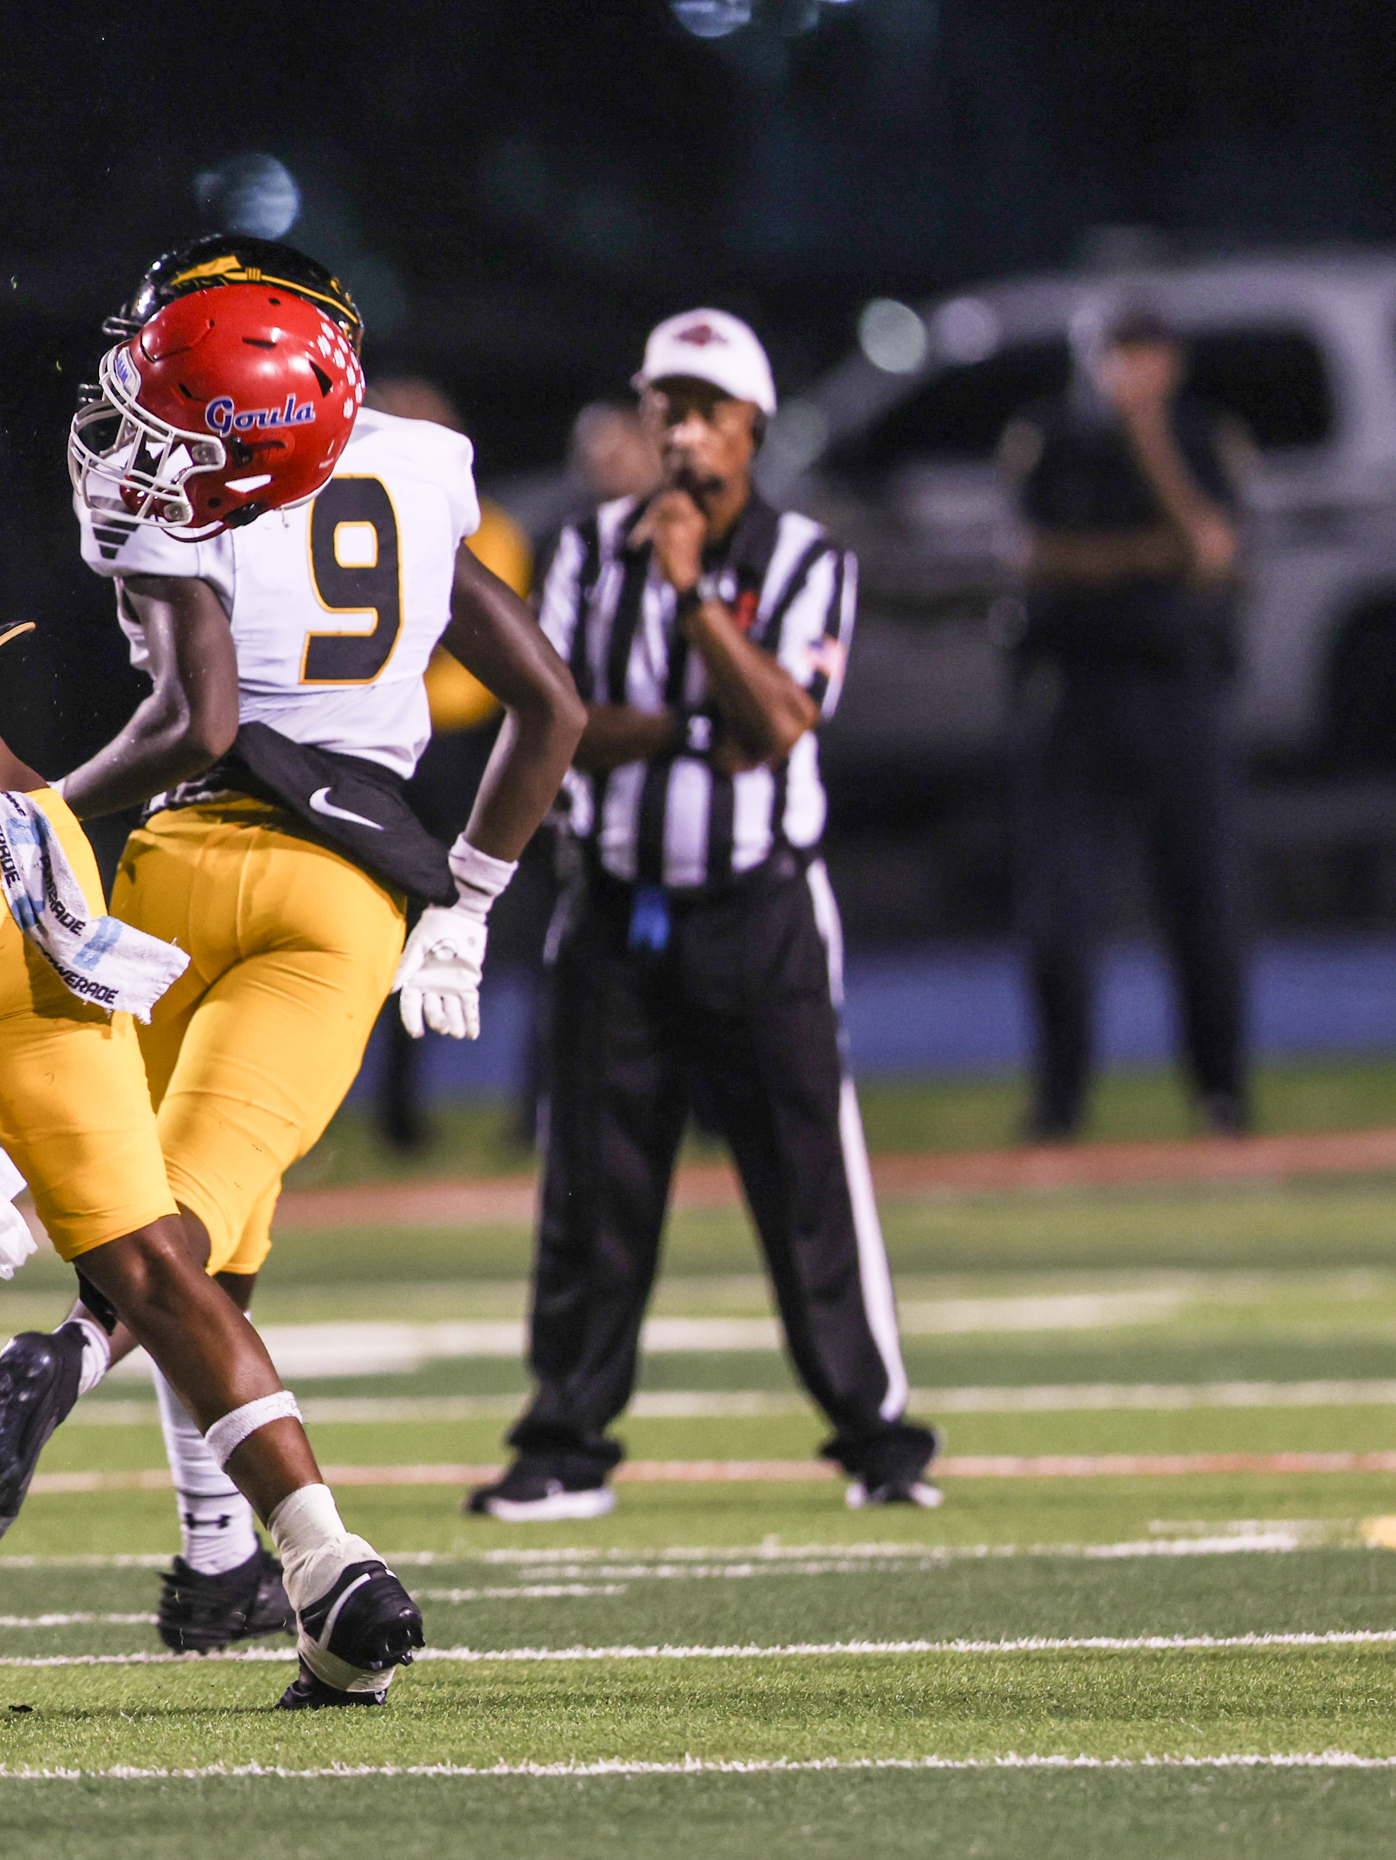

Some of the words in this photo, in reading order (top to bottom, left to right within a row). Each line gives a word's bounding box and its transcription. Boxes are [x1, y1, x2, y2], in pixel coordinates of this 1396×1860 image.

[205, 393, 315, 437] Goula
[299, 473, 404, 686] 9
[36, 940, 119, 1005] WERADE
